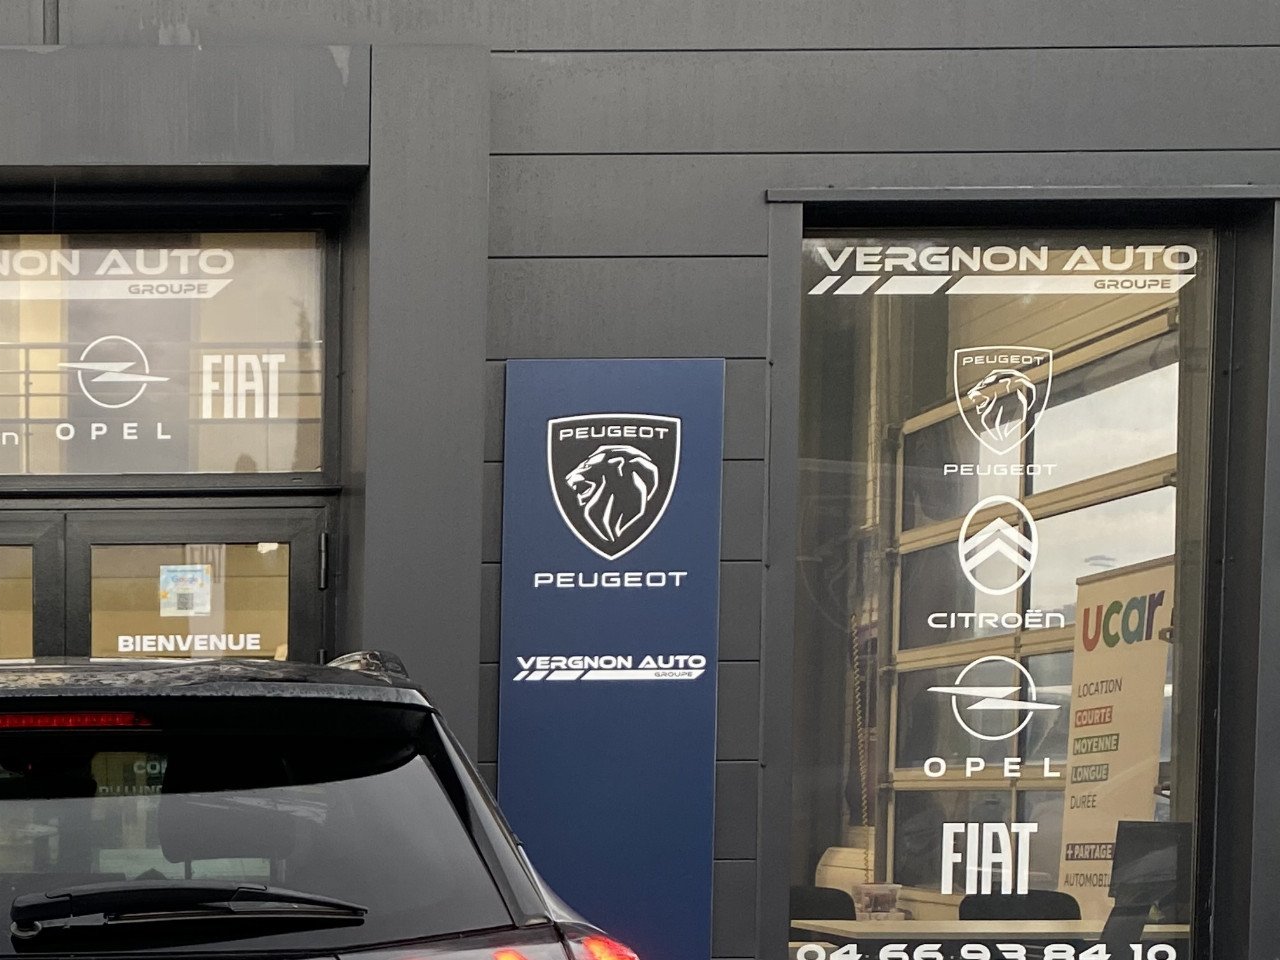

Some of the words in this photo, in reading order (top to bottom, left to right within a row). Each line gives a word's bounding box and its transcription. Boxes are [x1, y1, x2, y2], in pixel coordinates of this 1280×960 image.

[94, 247, 235, 276] AUTO
[816, 245, 1048, 272] VERGNON
[1062, 244, 1199, 271] AUTO
[127, 282, 209, 296] GROUPE
[1093, 278, 1172, 290] GROUPE
[962, 354, 1047, 367] PEUGEOT
[200, 353, 286, 420] FIAT
[55, 421, 172, 441] OPEL
[559, 425, 670, 441] PEUGEOT
[943, 462, 1058, 477] PEUGEOT
[533, 571, 689, 588] PEUGEOT
[1081, 589, 1166, 653] ucar
[117, 633, 261, 653] BIENVENUE
[516, 655, 633, 670] VERGNON
[638, 654, 707, 669] AUTO
[1077, 676, 1123, 698] LOCATION
[1075, 708, 1113, 727] COURTE
[1073, 734, 1119, 755] MOYENNE
[923, 757, 1061, 778] OPEL
[1071, 764, 1109, 783] LONGUE
[1070, 792, 1097, 810] DURÉE
[939, 821, 1039, 895] FIAT
[1064, 872, 1111, 888] AUTOMOBIL
